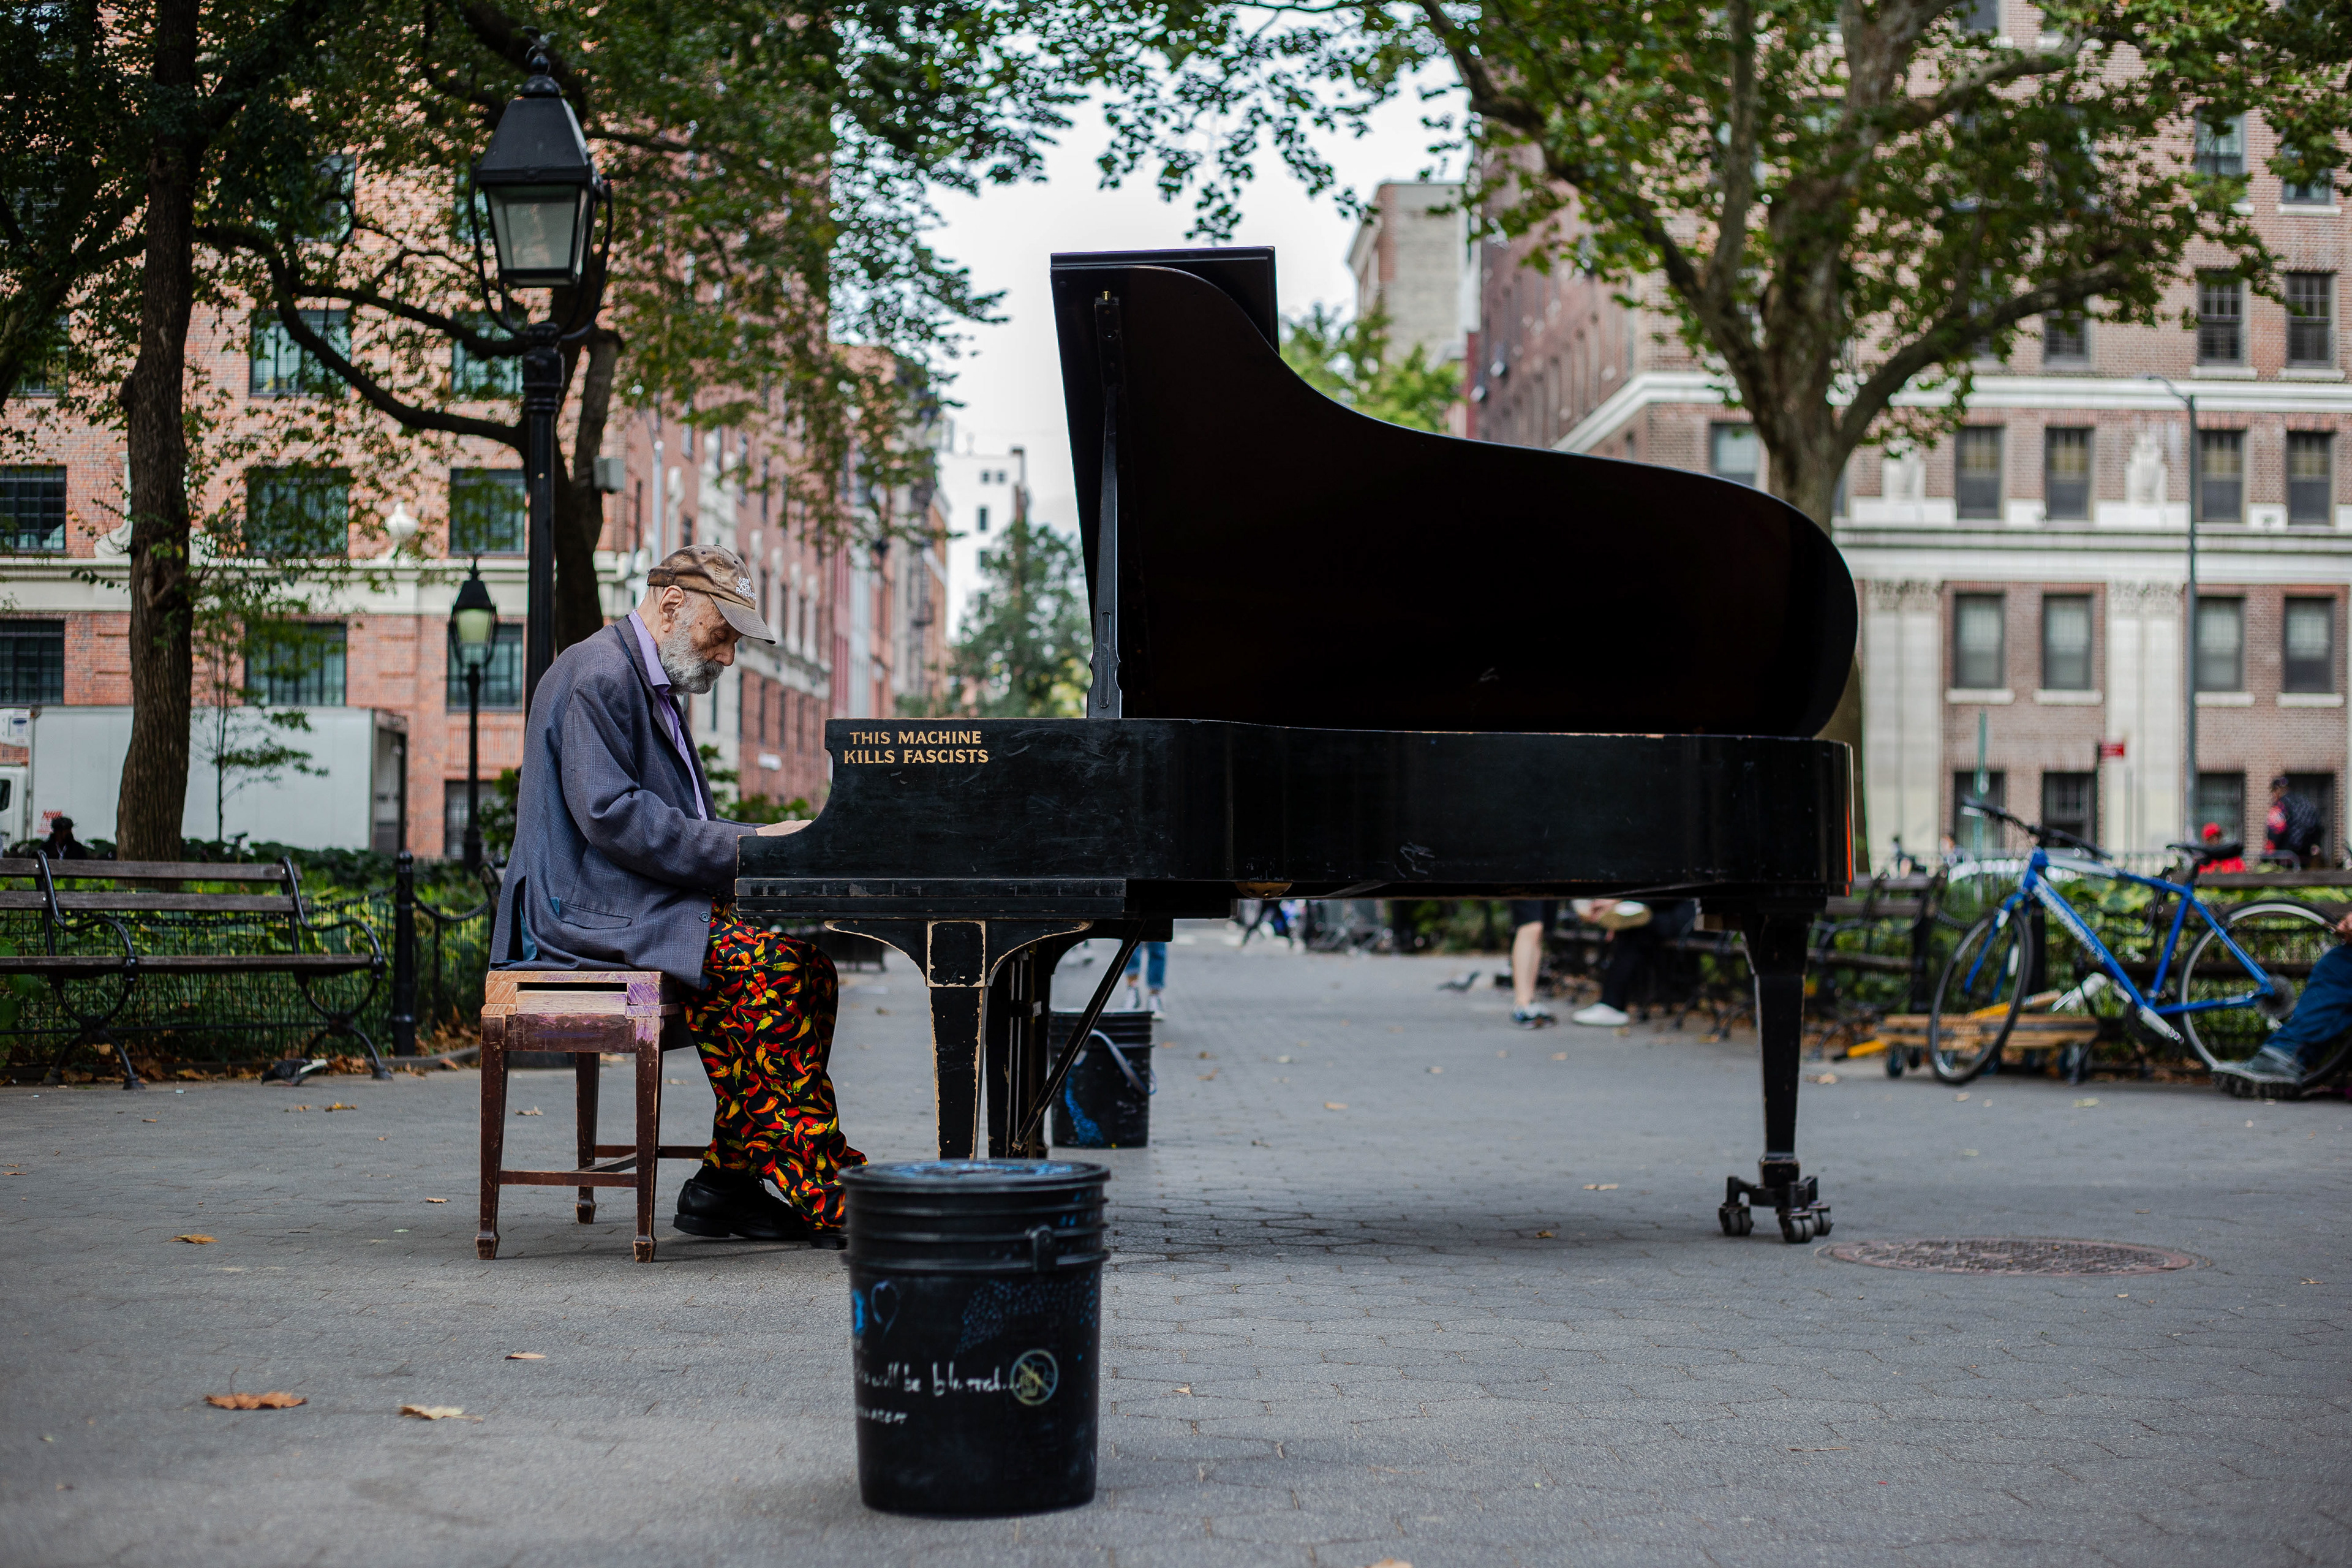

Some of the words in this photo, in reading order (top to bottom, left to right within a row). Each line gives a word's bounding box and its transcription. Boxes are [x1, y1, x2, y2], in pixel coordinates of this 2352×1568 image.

[850, 731, 891, 745] THIS
[898, 731, 982, 745] MACHINE
[844, 750, 895, 764] KILLS
[903, 749, 989, 764] FASCISTS
